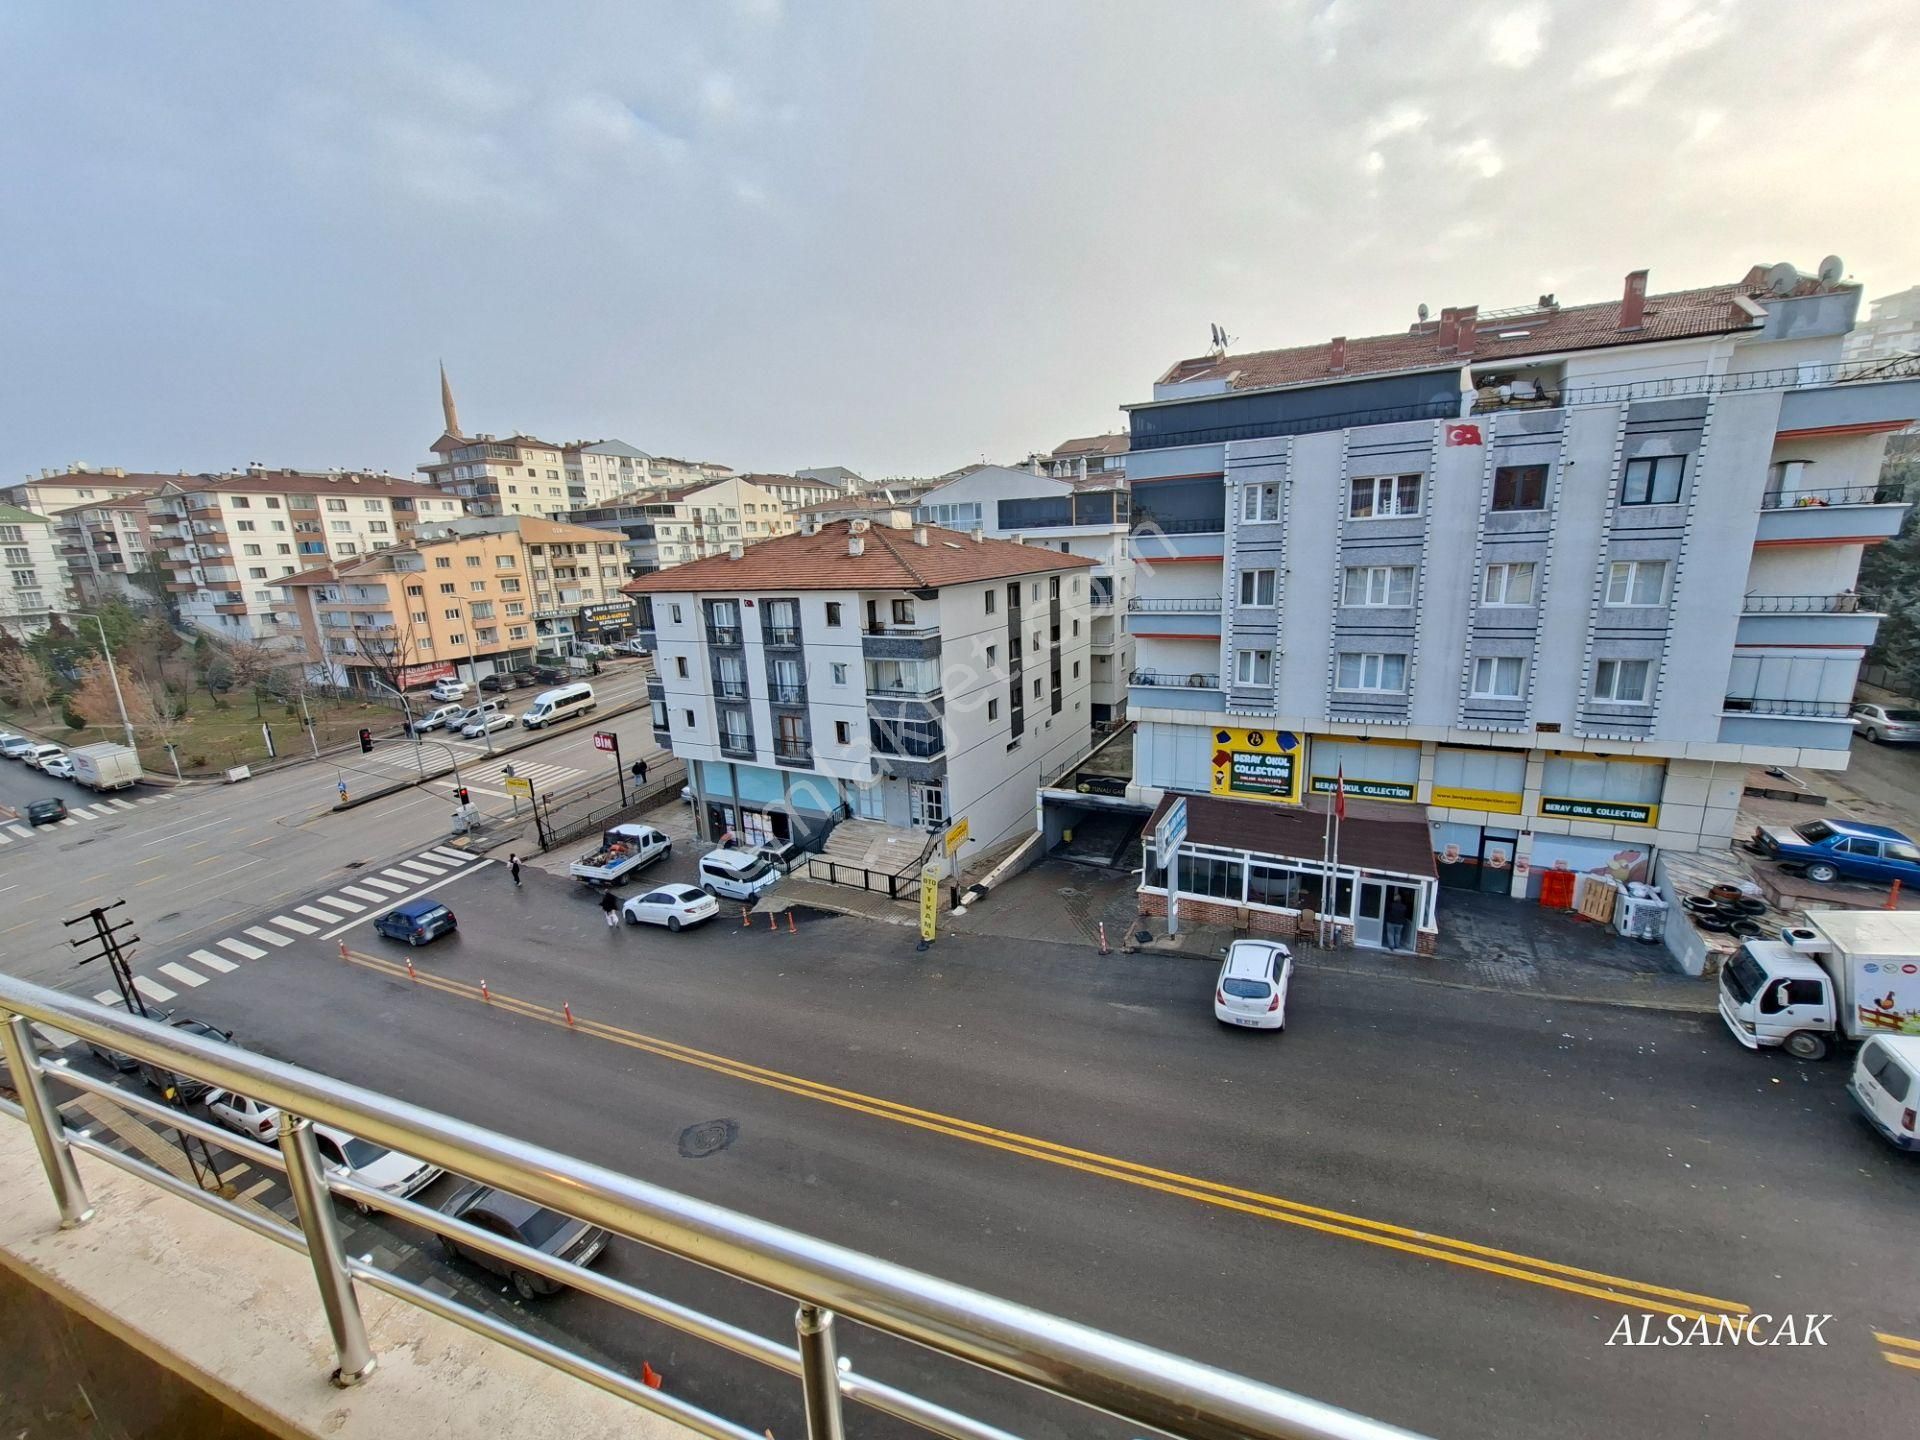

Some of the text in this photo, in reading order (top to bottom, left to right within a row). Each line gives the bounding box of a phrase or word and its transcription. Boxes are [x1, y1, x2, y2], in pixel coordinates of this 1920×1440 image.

[1233, 754, 1290, 766] BERAY OKUL
[1315, 782, 1338, 791] BERAY
[1545, 803, 1570, 813] BERAY
[1572, 806, 1593, 815] OKUL
